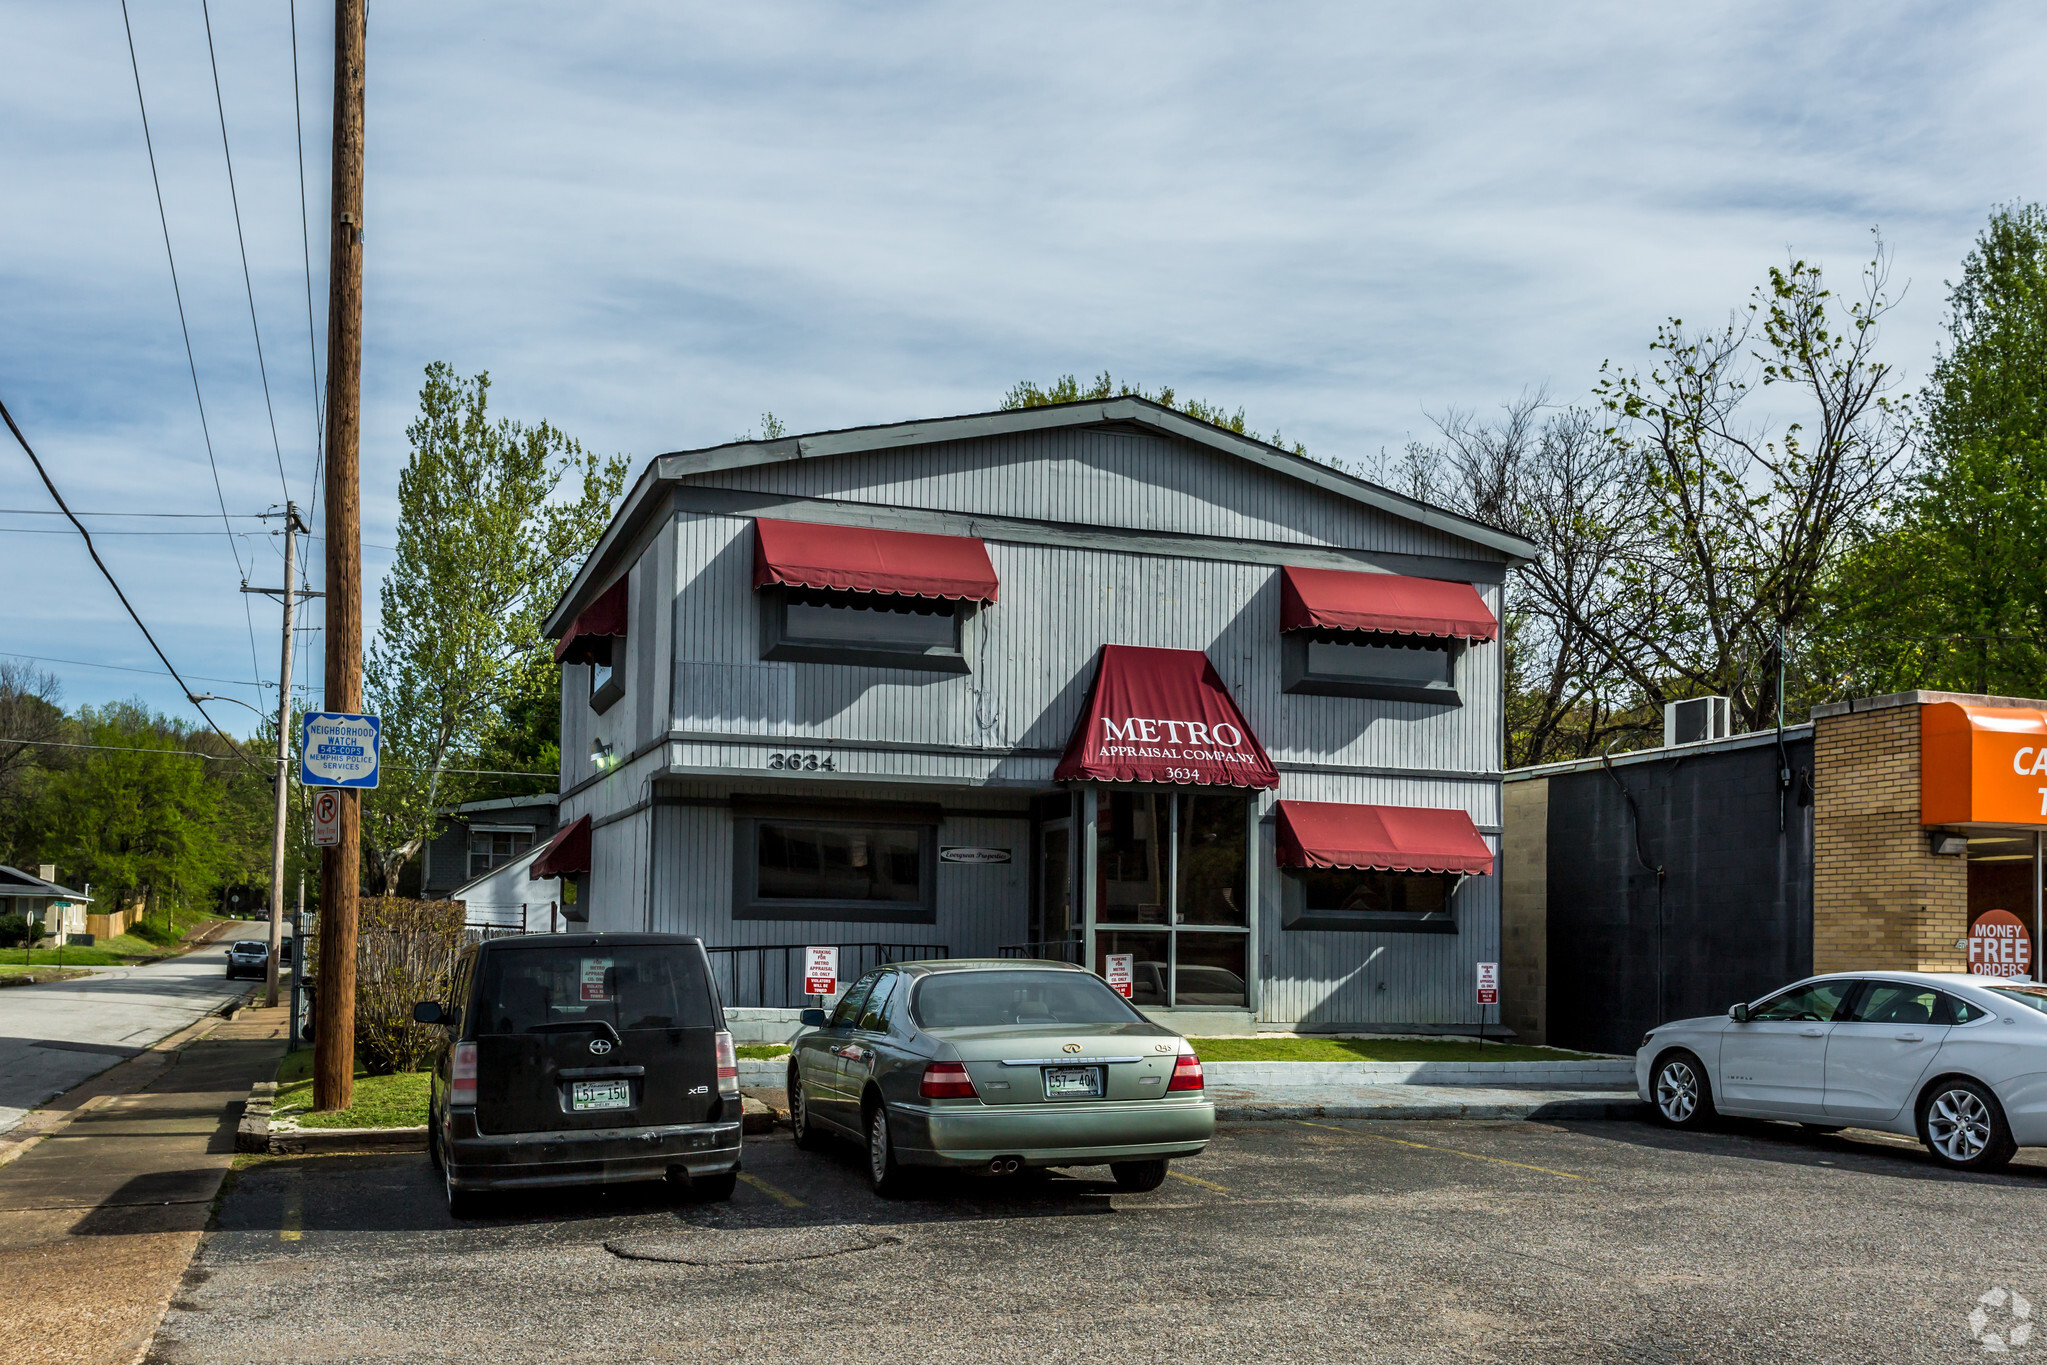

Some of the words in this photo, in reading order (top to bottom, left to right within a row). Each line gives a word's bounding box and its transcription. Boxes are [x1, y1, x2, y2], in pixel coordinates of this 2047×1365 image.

[310, 725, 374, 738] NEIGHBORHOOD
[1101, 717, 1242, 748] METRO
[328, 736, 357, 746] WATCH
[320, 745, 361, 755] 545-COPS
[1099, 745, 1182, 759] APPRAISAL
[1183, 749, 1255, 764] COMPANY
[310, 754, 344, 762] MEMPHIS
[346, 755, 373, 764] POLICE
[768, 752, 837, 772] 3634
[323, 762, 360, 771] SERVICES
[1166, 767, 1200, 780] 3634
[945, 850, 975, 859] Evergreen
[976, 851, 1007, 861] Properties
[1975, 924, 2022, 938] MONEY
[1969, 937, 2028, 963] FREE
[1973, 963, 2024, 976] ORDERS
[688, 1085, 709, 1095] xB
